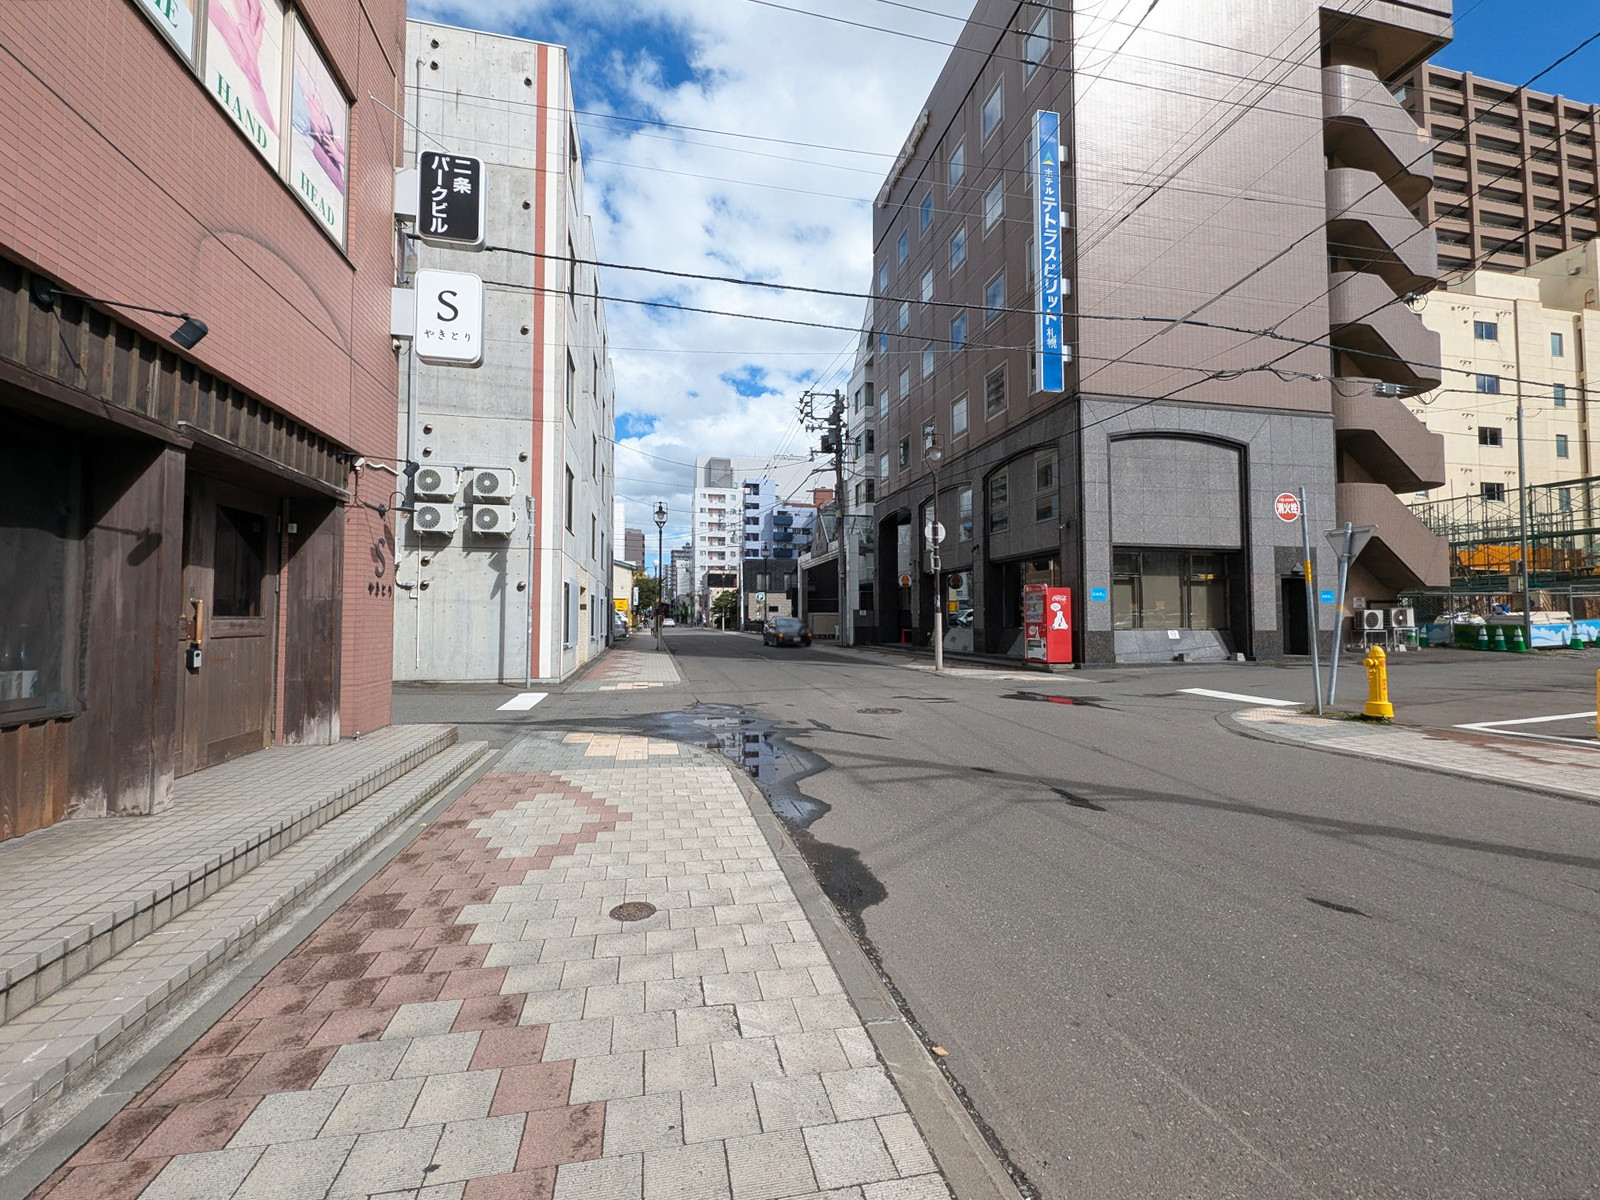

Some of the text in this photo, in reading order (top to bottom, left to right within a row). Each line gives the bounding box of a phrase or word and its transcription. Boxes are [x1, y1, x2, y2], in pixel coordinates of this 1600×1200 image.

[216, 71, 267, 149] HAND
[429, 155, 451, 233] パークビル
[452, 159, 472, 194] 二条
[1044, 168, 1055, 195] ホテル
[300, 169, 335, 226] HEAD
[436, 290, 459, 322] S
[424, 329, 471, 342] やきとり
[1277, 502, 1298, 514] 消火栓
[375, 538, 386, 578] S
